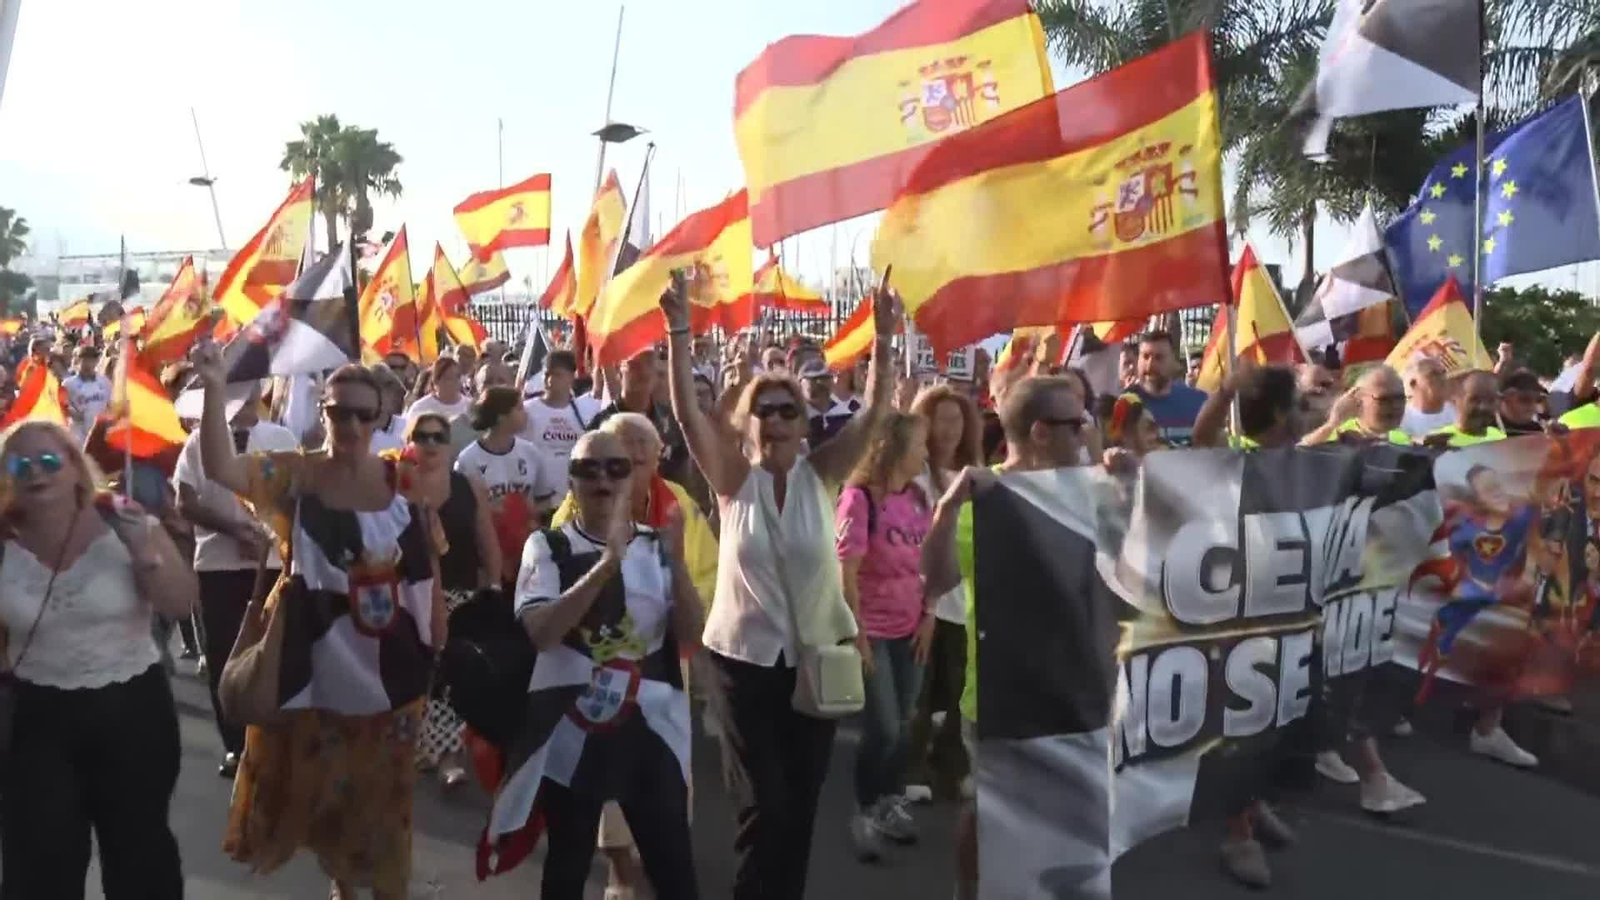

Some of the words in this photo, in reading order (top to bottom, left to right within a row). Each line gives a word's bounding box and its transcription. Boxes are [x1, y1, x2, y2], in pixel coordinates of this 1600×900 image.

[886, 525, 922, 546] Ceu
[1162, 495, 1377, 625] CEUA
[1109, 646, 1209, 769] NO
[1223, 630, 1315, 737] SE
[1322, 588, 1399, 678] NDE
